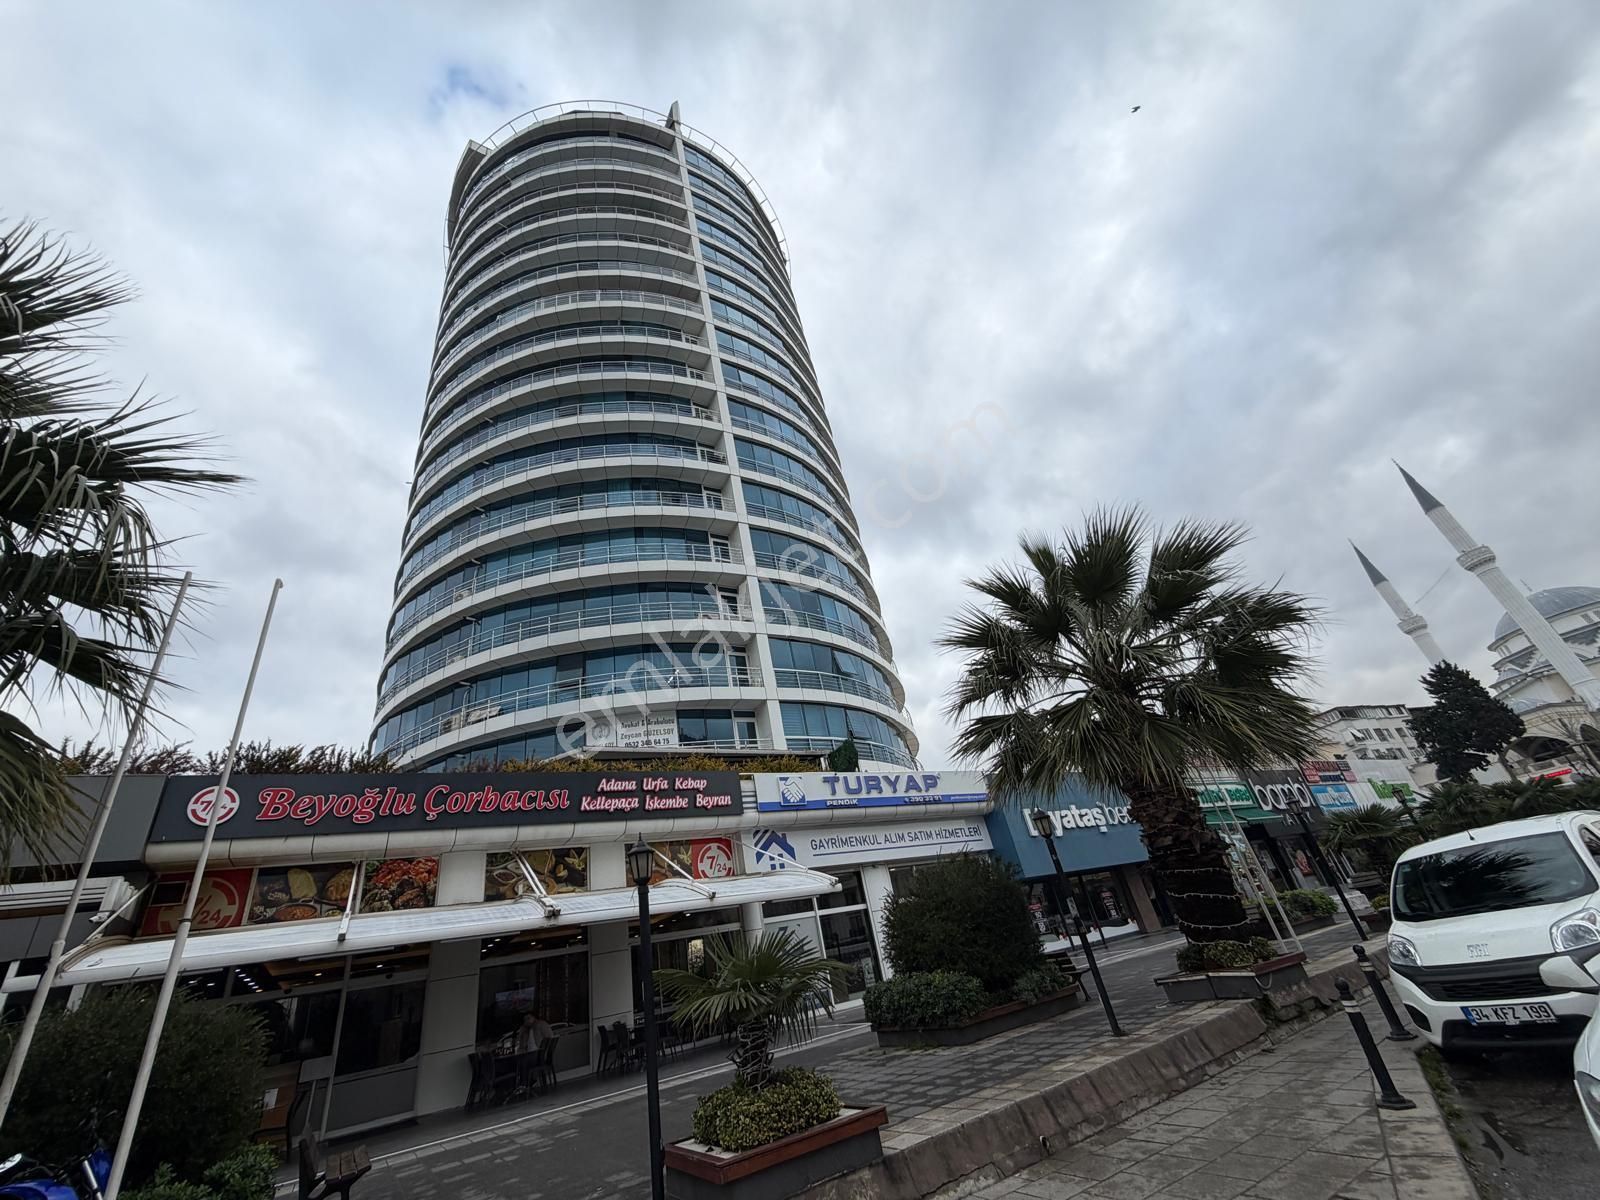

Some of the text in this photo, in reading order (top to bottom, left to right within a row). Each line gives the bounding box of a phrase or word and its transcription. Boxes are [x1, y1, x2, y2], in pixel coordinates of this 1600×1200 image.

[596, 775, 708, 793] Adana Urfa Kebap
[822, 775, 938, 795] TURYAP
[1247, 777, 1317, 811] bambi
[256, 785, 570, 826] Beyoğlu Çorbacısı
[580, 796, 640, 814] Kellepaça
[695, 792, 733, 808] Beyran
[810, 824, 983, 852] GAYRİMENKUL ALIM SATIM HİZMETLERİ
[706, 853, 728, 876] 7/24
[1471, 1008, 1490, 1021] 34
[1491, 1006, 1520, 1020] KFZ
[1522, 1004, 1551, 1019] 199
